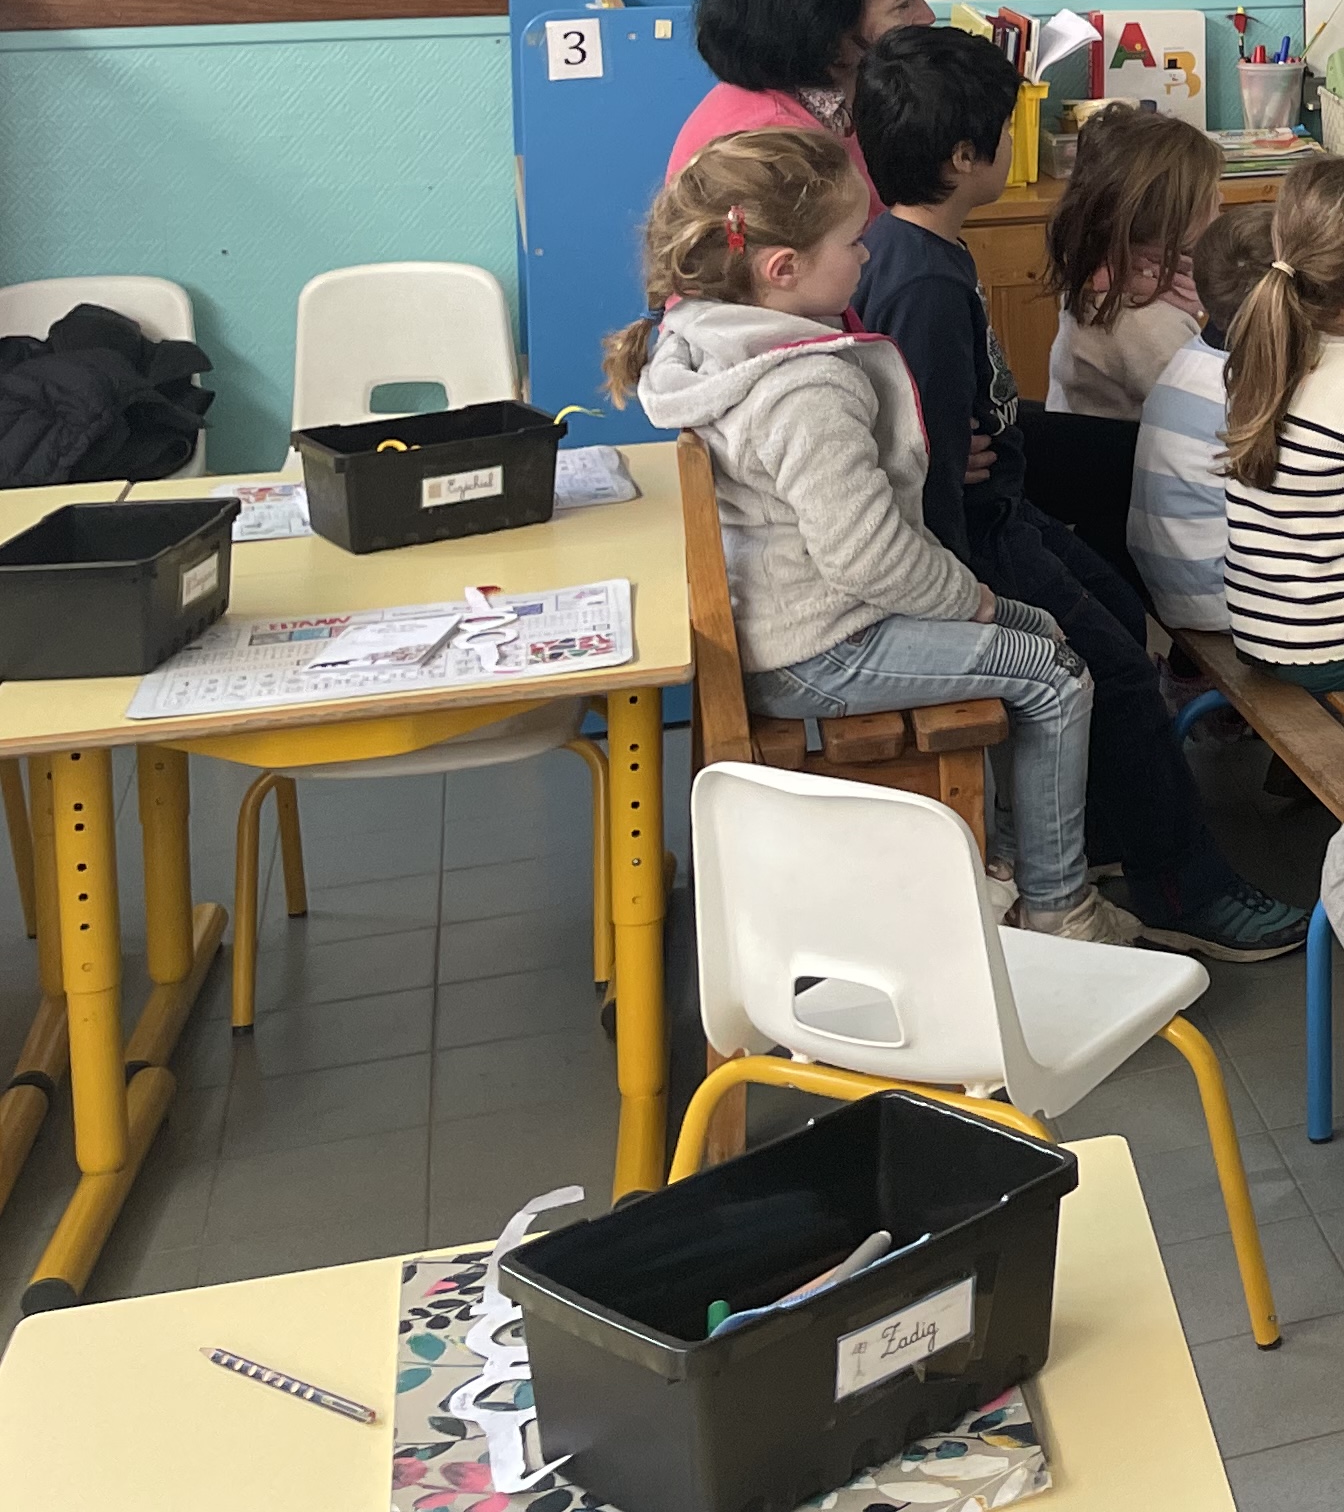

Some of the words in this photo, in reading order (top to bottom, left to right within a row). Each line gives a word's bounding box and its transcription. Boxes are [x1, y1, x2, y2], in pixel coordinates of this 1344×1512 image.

[562, 31, 588, 66] 3
[1109, 22, 1157, 69] A
[880, 1321, 939, 1359] Zadig
